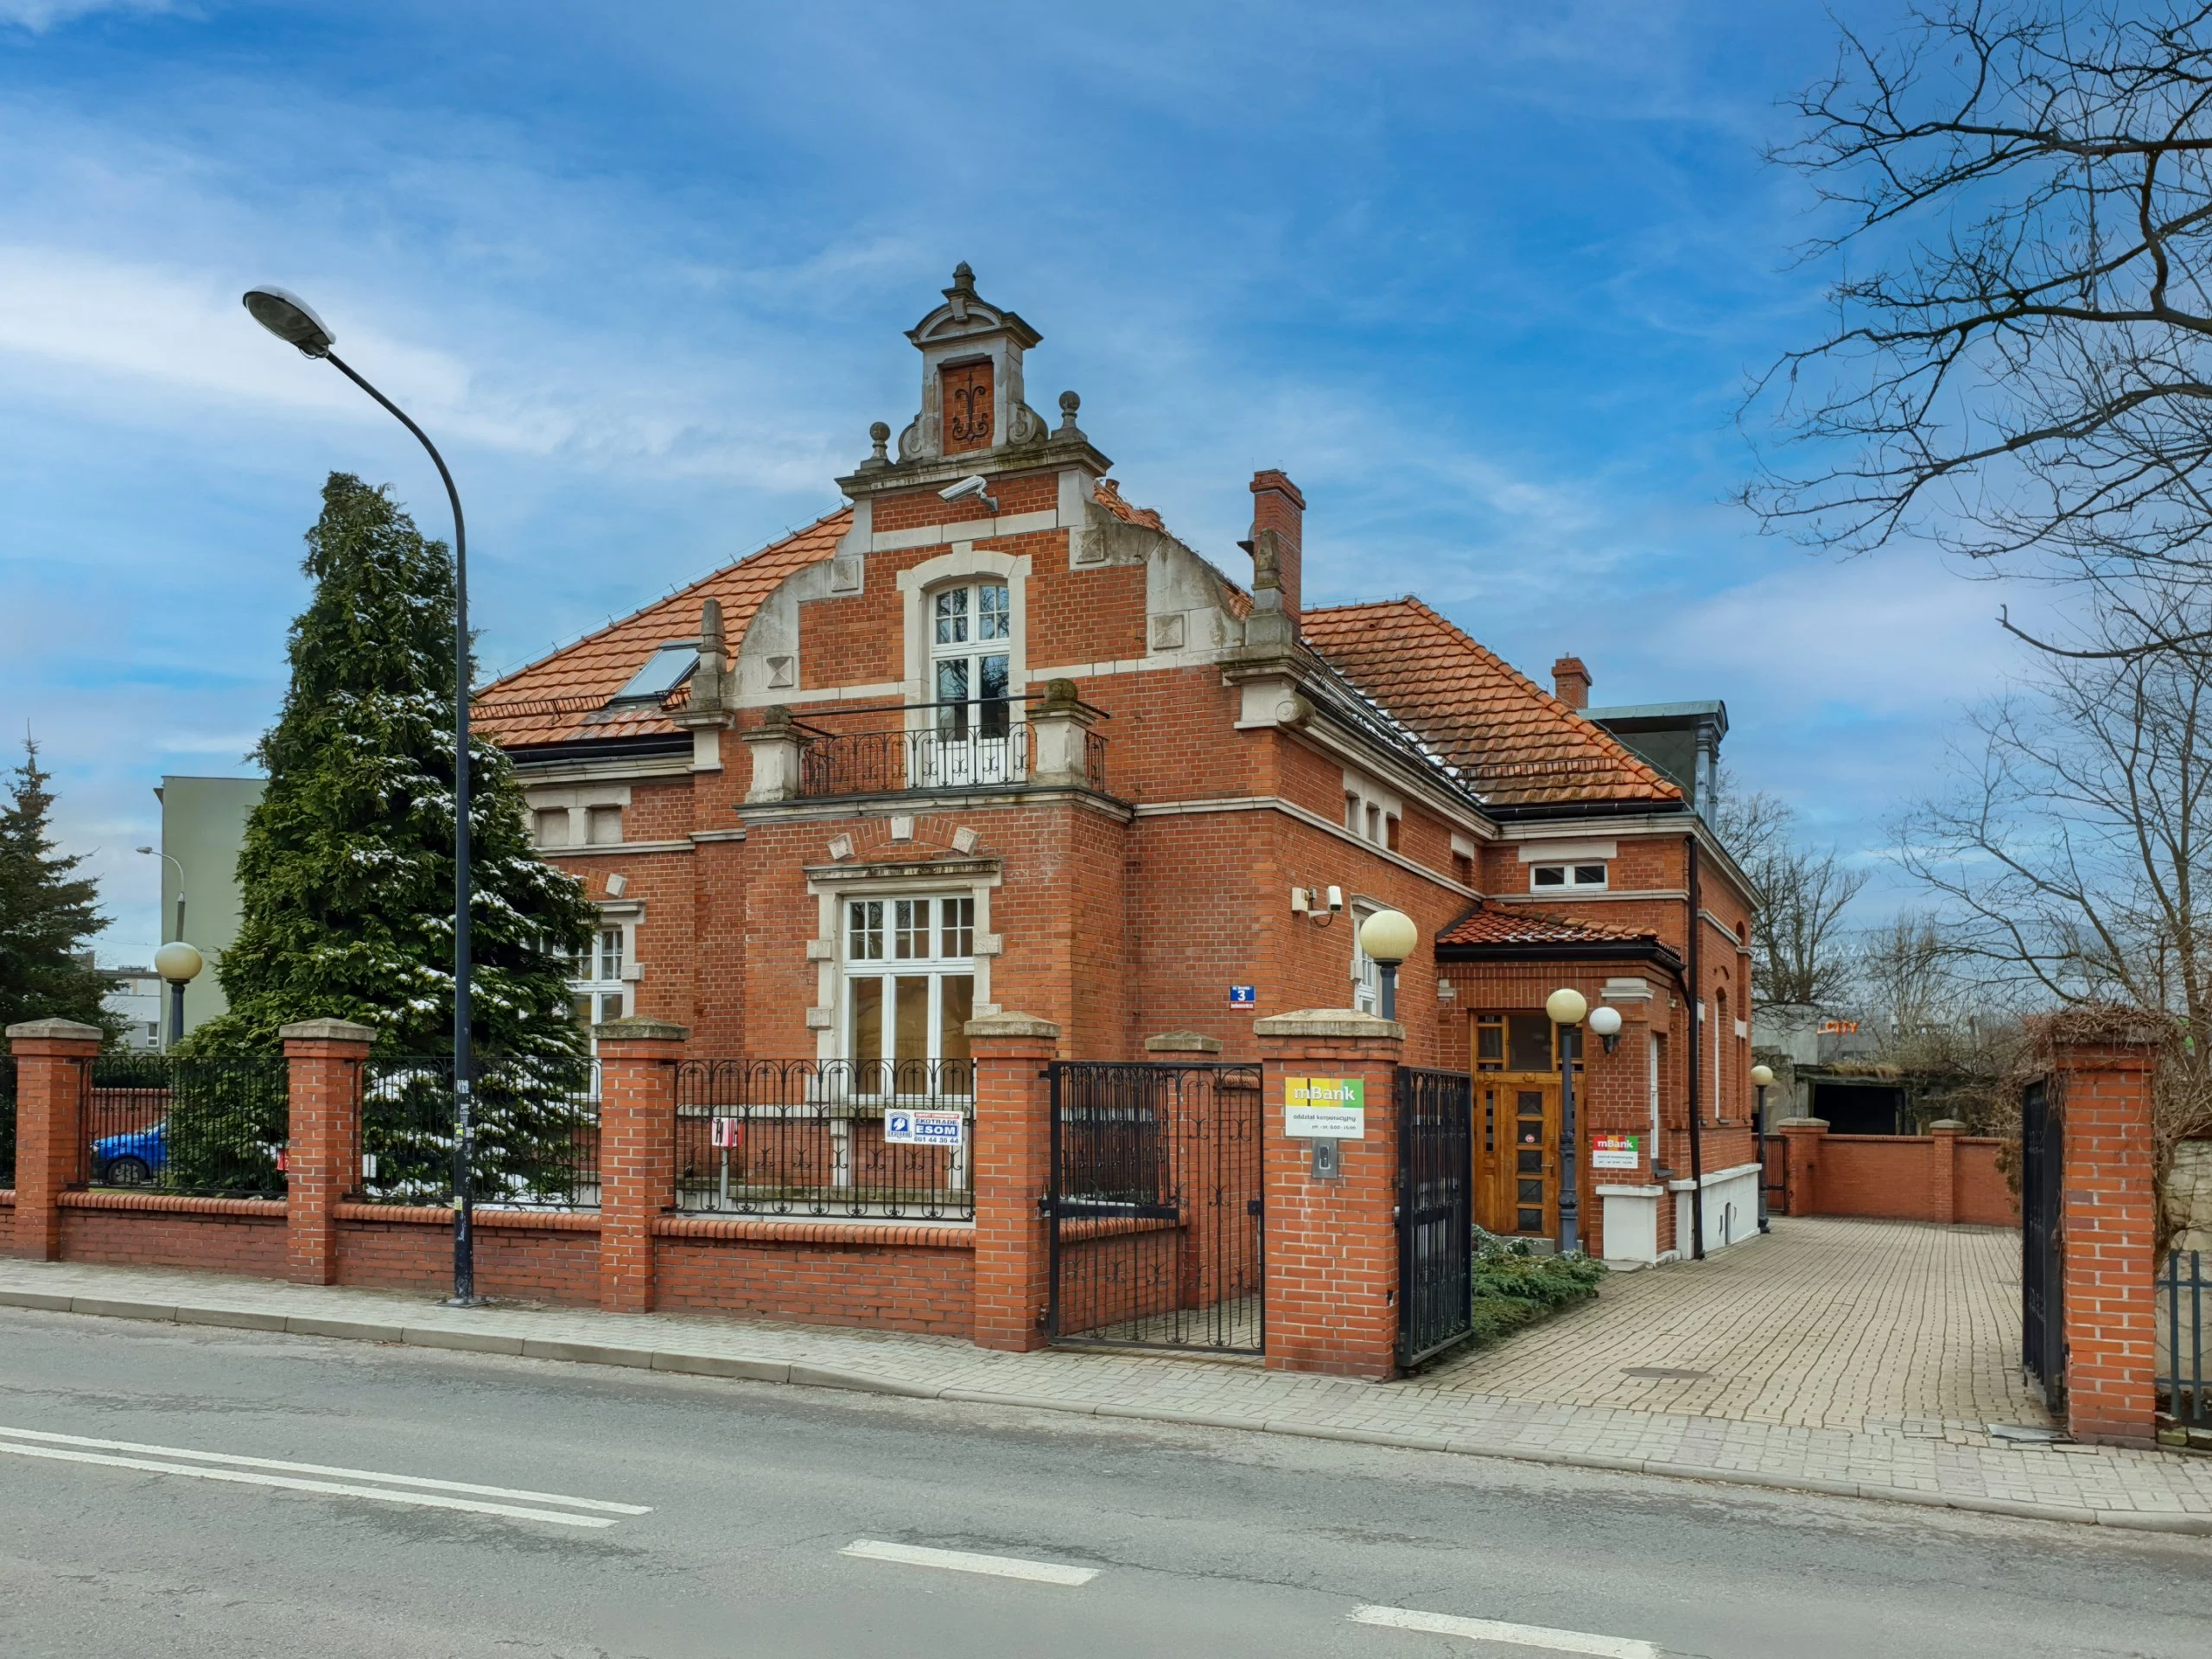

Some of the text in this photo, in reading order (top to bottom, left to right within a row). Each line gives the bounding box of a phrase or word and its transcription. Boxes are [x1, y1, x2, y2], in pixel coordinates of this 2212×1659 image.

[1237, 990, 1246, 1001] 3
[1294, 1085, 1356, 1101] mBank
[916, 1126, 956, 1135] ESOM
[1597, 1140, 1634, 1148] mBank
